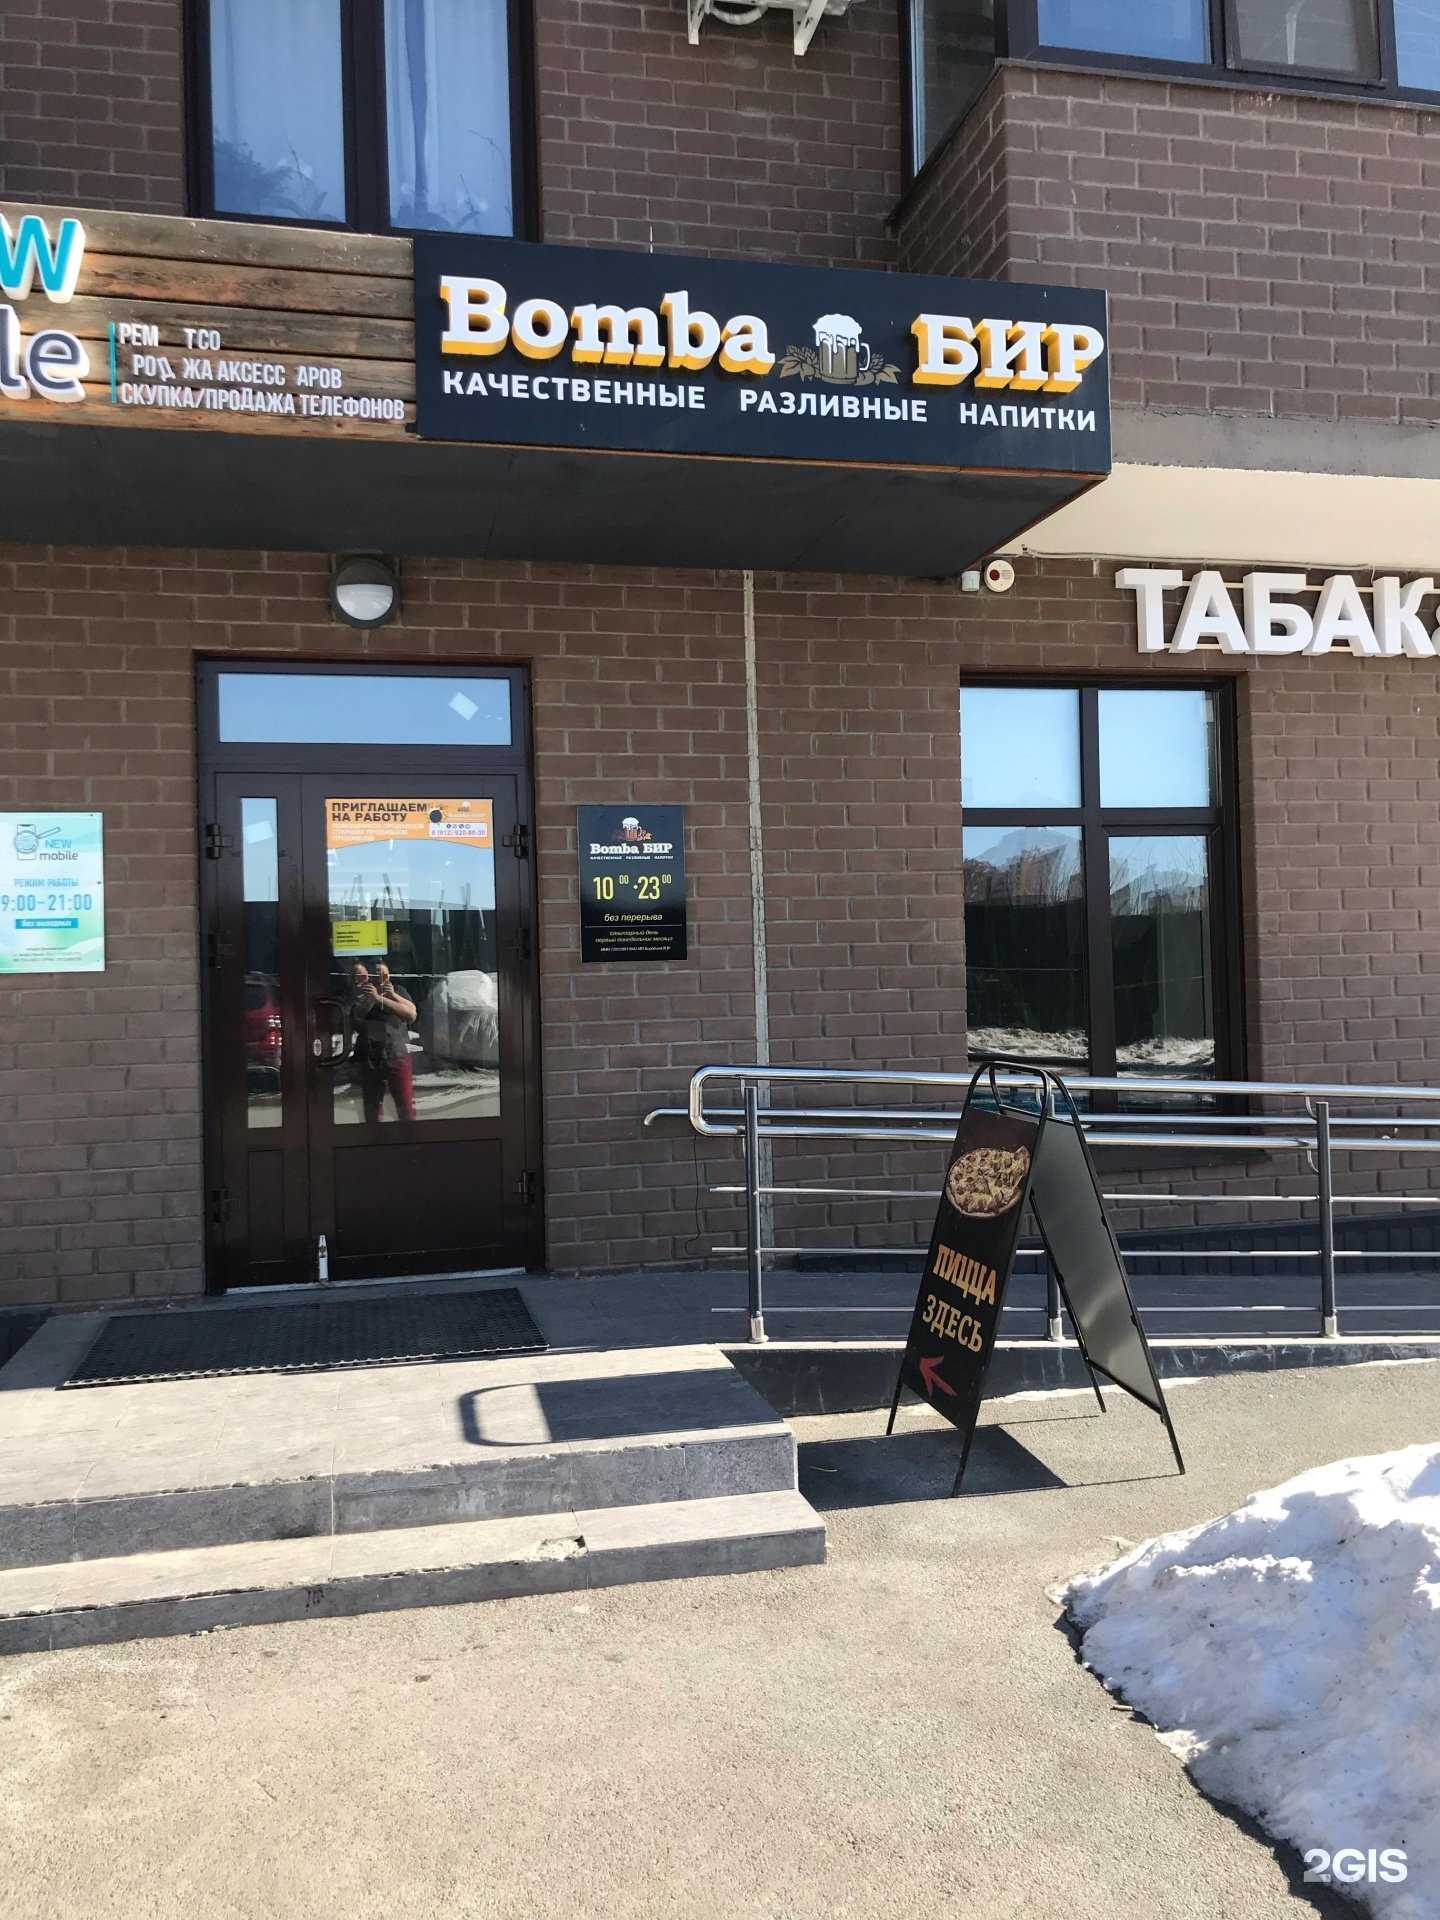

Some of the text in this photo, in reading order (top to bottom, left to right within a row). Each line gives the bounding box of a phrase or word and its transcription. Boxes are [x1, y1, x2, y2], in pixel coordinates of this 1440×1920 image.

[440, 275, 776, 375] Bomba
[911, 313, 1105, 393] БИР
[121, 382, 405, 420] СКУПКА/ПРОДАЖА ТЕЛЕФОНОВ
[442, 370, 1097, 433] КАЧЕСТВЕННЫЕ РАЗЛИВНЫЕ НАПИТКИ
[1115, 568, 1440, 659] ТАБАК
[332, 803, 427, 812] ПРИГЛАШАЕМ
[332, 813, 407, 822] НА РАБОТУ
[40, 851, 79, 861] mobile
[45, 840, 72, 848] NEW
[590, 843, 640, 854] Bomba
[643, 843, 673, 854] БИР
[593, 876, 614, 900] 10
[619, 874, 629, 884] 00
[661, 874, 672, 884] 00
[932, 1243, 997, 1306] ПИЦЦА
[922, 1294, 983, 1353] ЗДЕСЬ
